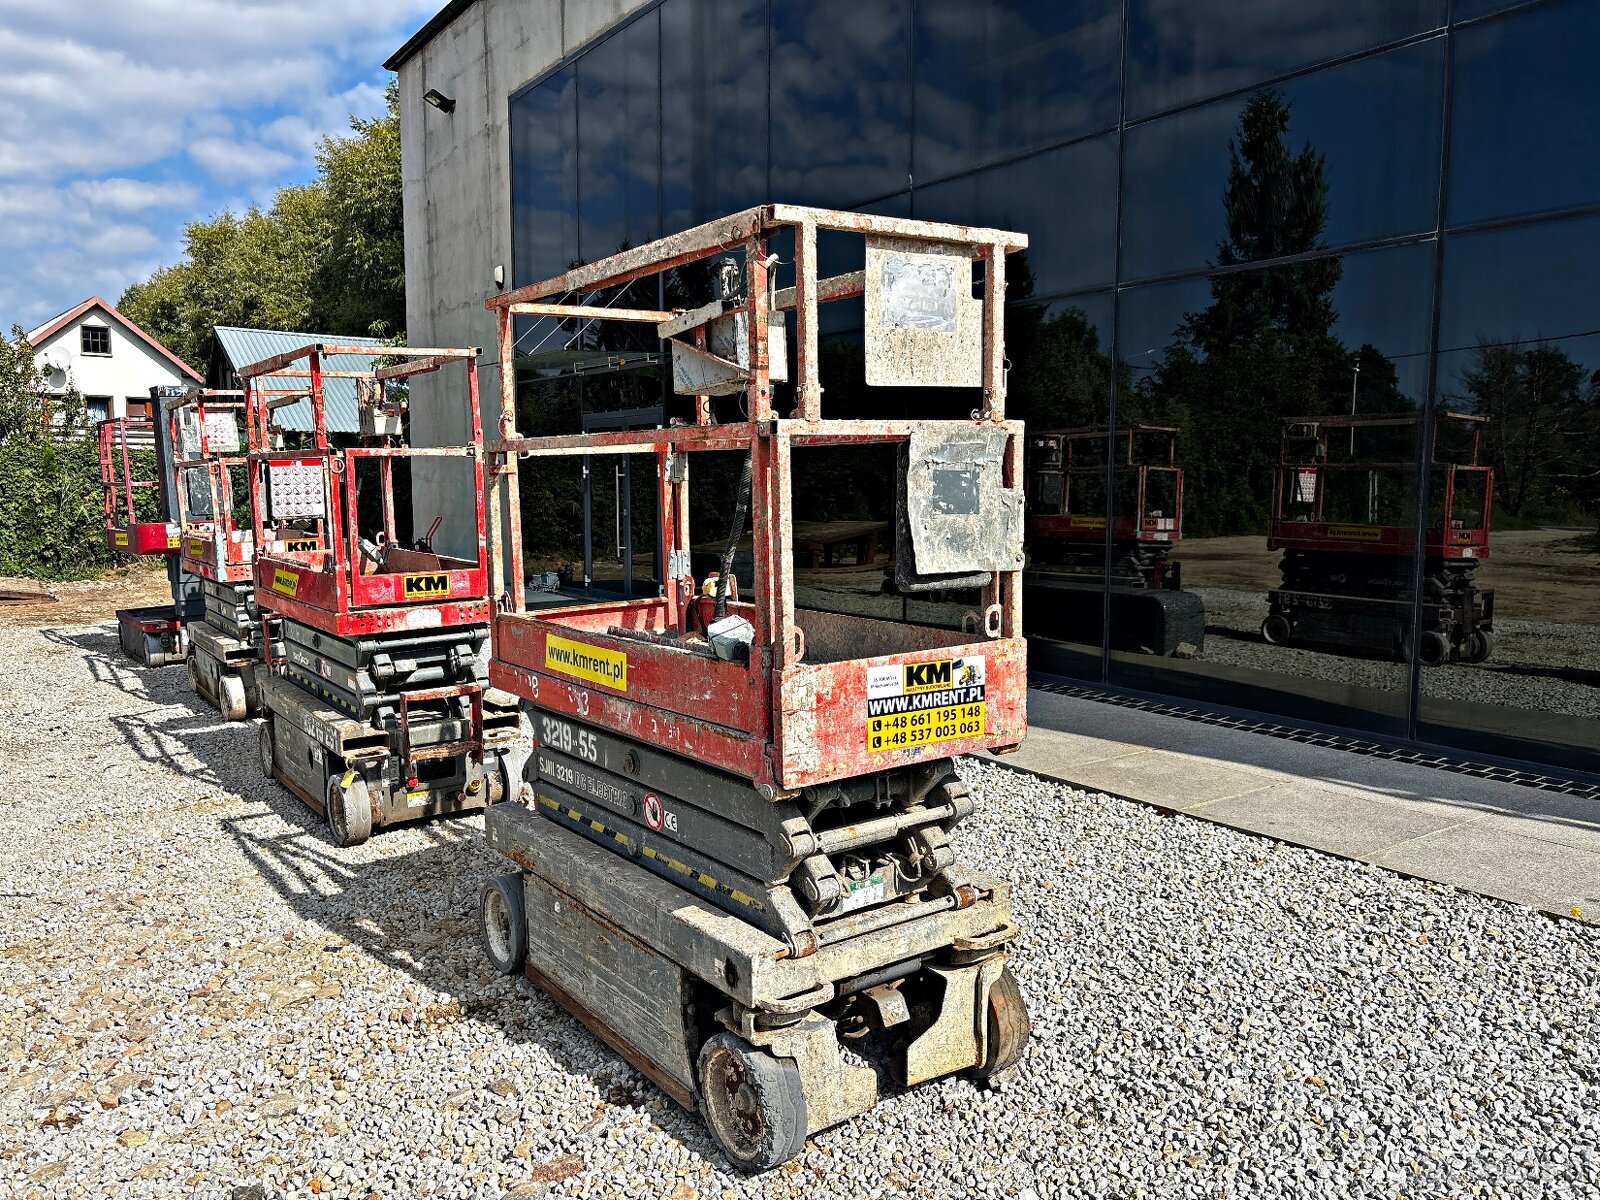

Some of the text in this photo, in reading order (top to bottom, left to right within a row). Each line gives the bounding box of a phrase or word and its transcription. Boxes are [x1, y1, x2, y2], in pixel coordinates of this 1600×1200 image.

[287, 540, 318, 552] KM
[406, 575, 447, 593] KM
[547, 644, 624, 683] www.kmrent.pl
[906, 661, 951, 687] KM
[868, 689, 985, 716] WWW.KMRENT.PL
[884, 705, 980, 730] +48 661 195 148
[884, 721, 980, 746] +48 537 003 063
[556, 763, 573, 785] 3219
[574, 770, 587, 791] DC
[587, 776, 628, 809] ELECTRIC
